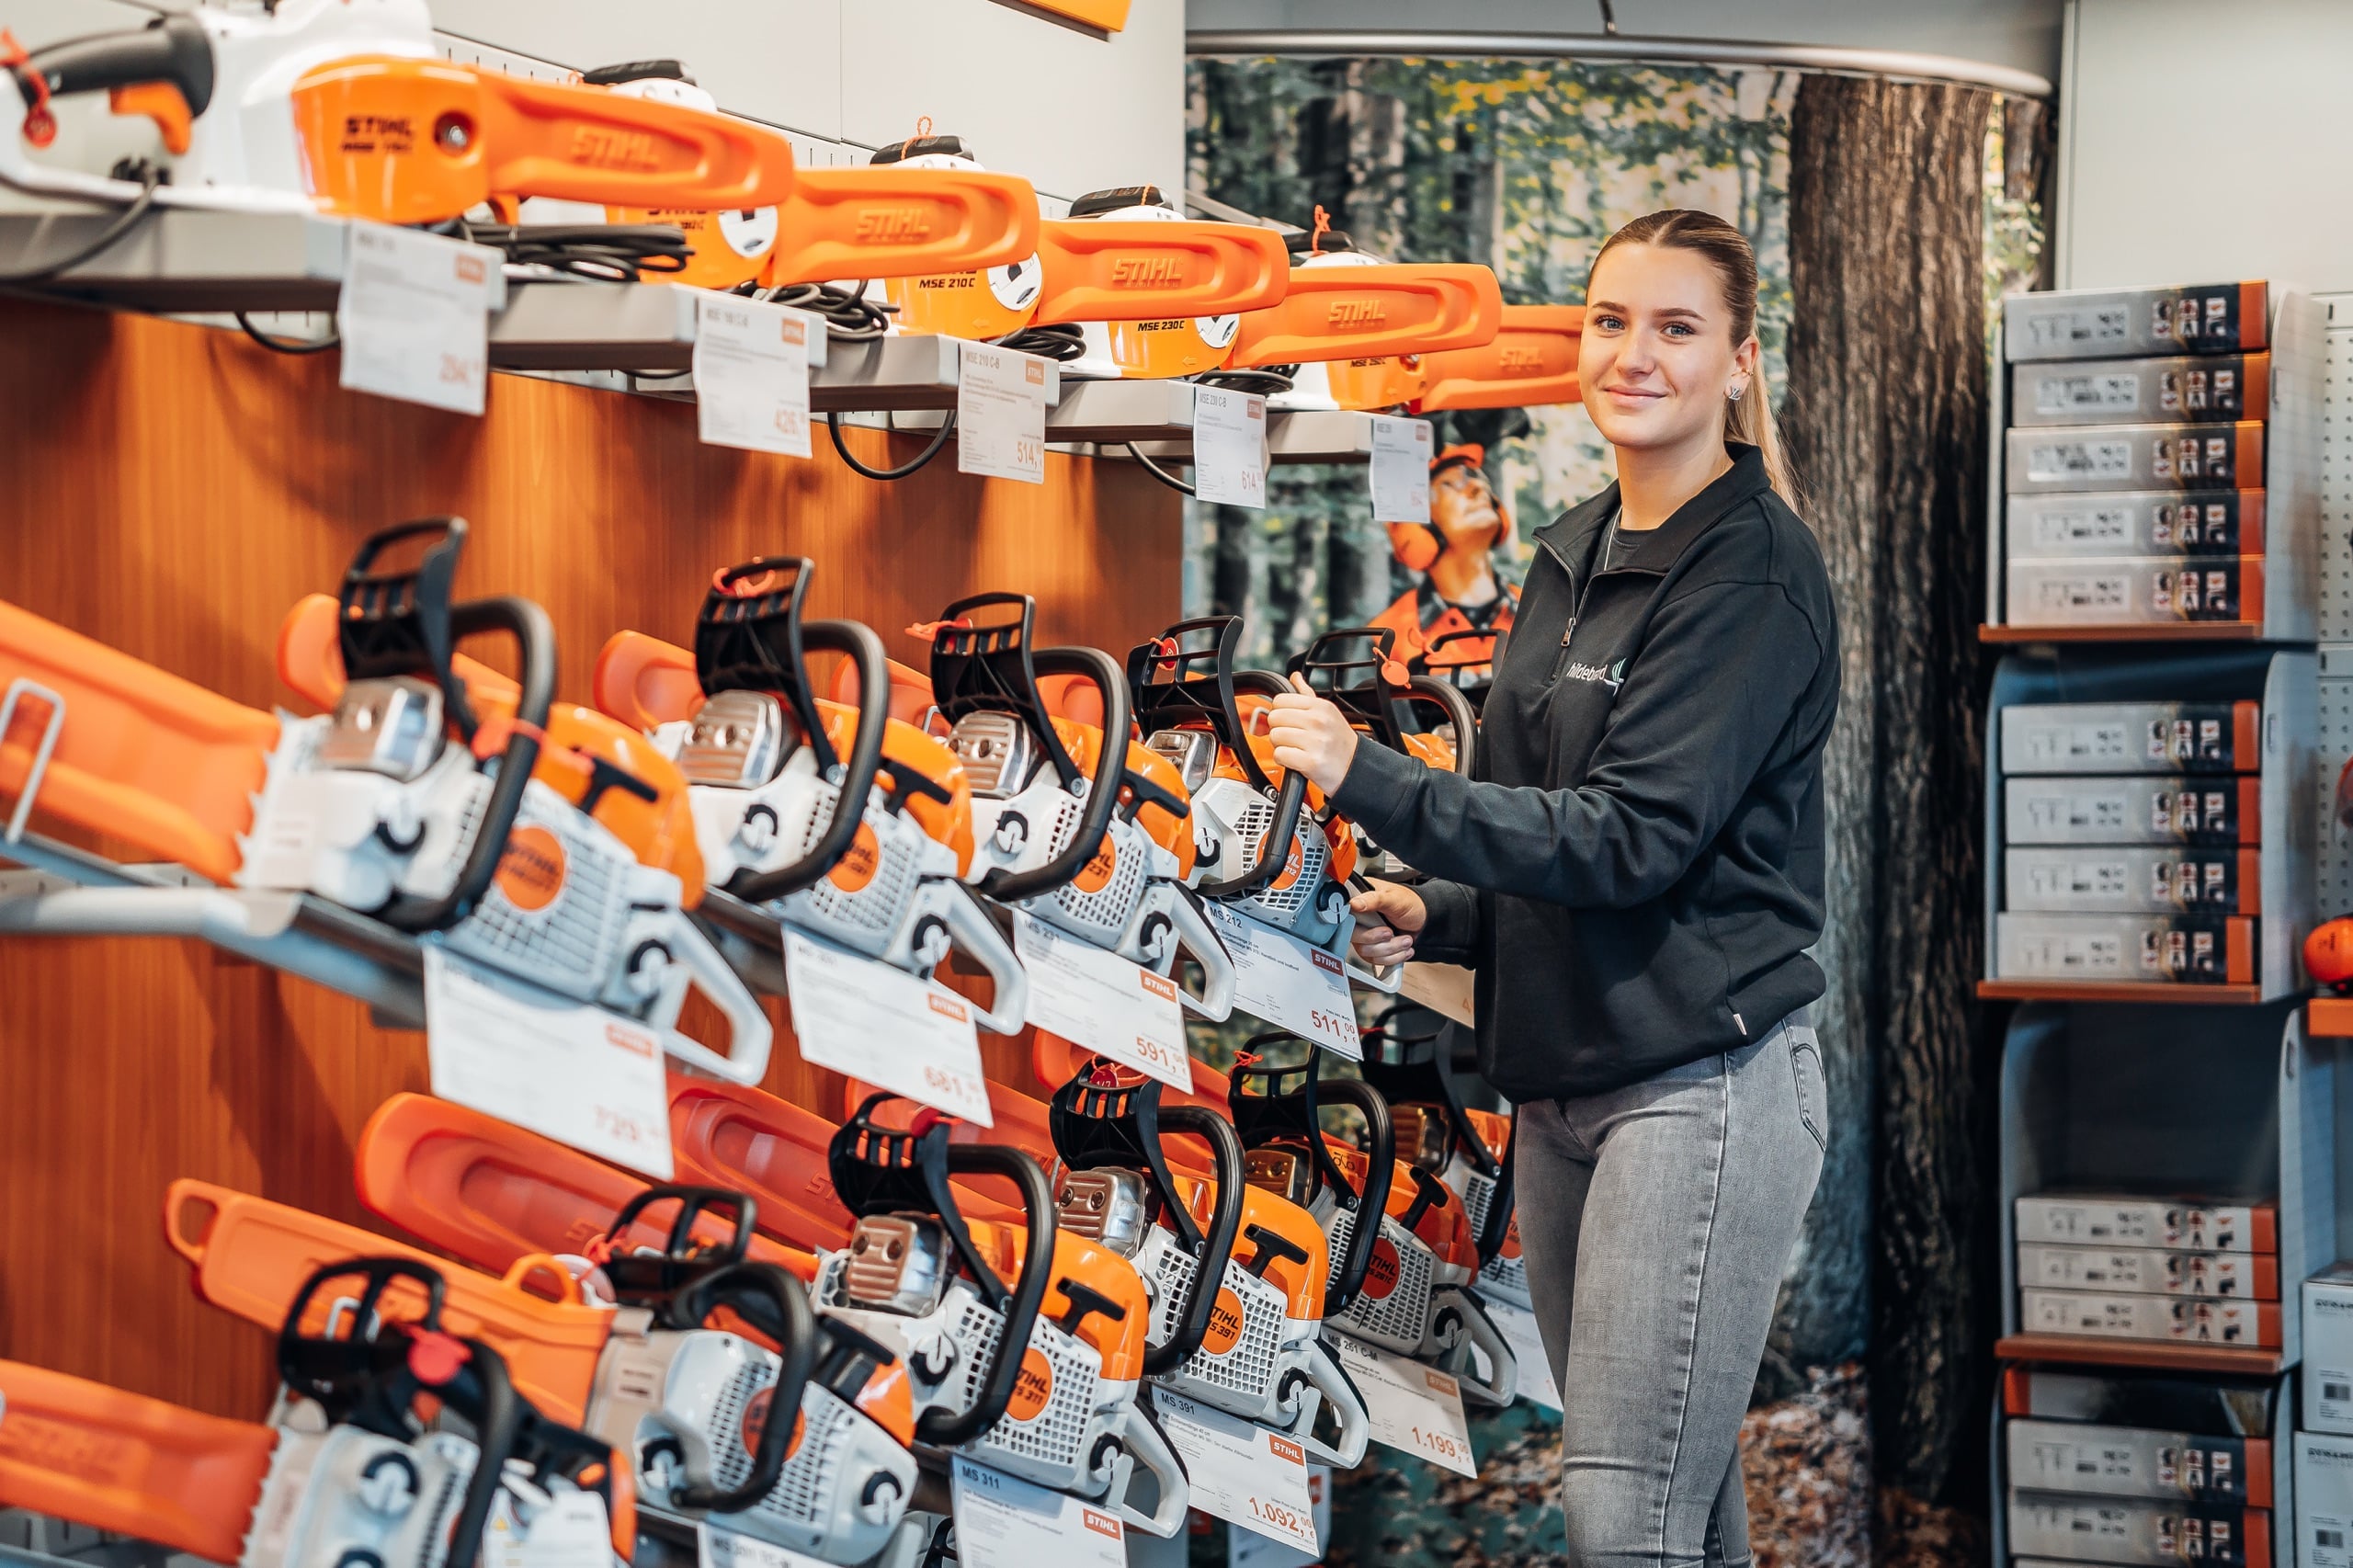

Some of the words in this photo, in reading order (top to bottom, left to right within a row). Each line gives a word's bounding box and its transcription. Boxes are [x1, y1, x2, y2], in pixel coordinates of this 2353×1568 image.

[857, 208, 929, 234] STIHL
[1113, 258, 1183, 281] STIHL
[919, 278, 945, 289] MSE
[1328, 300, 1386, 322] STIHL
[1137, 322, 1159, 332] MSE
[1210, 906, 1224, 921] MS
[1226, 914, 1243, 928] 212
[1314, 953, 1340, 971] STIHL
[1144, 976, 1174, 996] STIHL
[1370, 1255, 1396, 1277] TIHL
[1211, 1306, 1239, 1330] TIHL
[1217, 1325, 1235, 1340] 391
[1344, 1340, 1358, 1353] 261
[1017, 1368, 1047, 1394] TIHL
[1161, 1392, 1176, 1407] MS
[1178, 1400, 1195, 1415] 391
[1273, 1441, 1301, 1460] STIHL
[961, 1465, 979, 1482] MS
[982, 1472, 999, 1489] 311
[1086, 1514, 1117, 1533] STIHL
